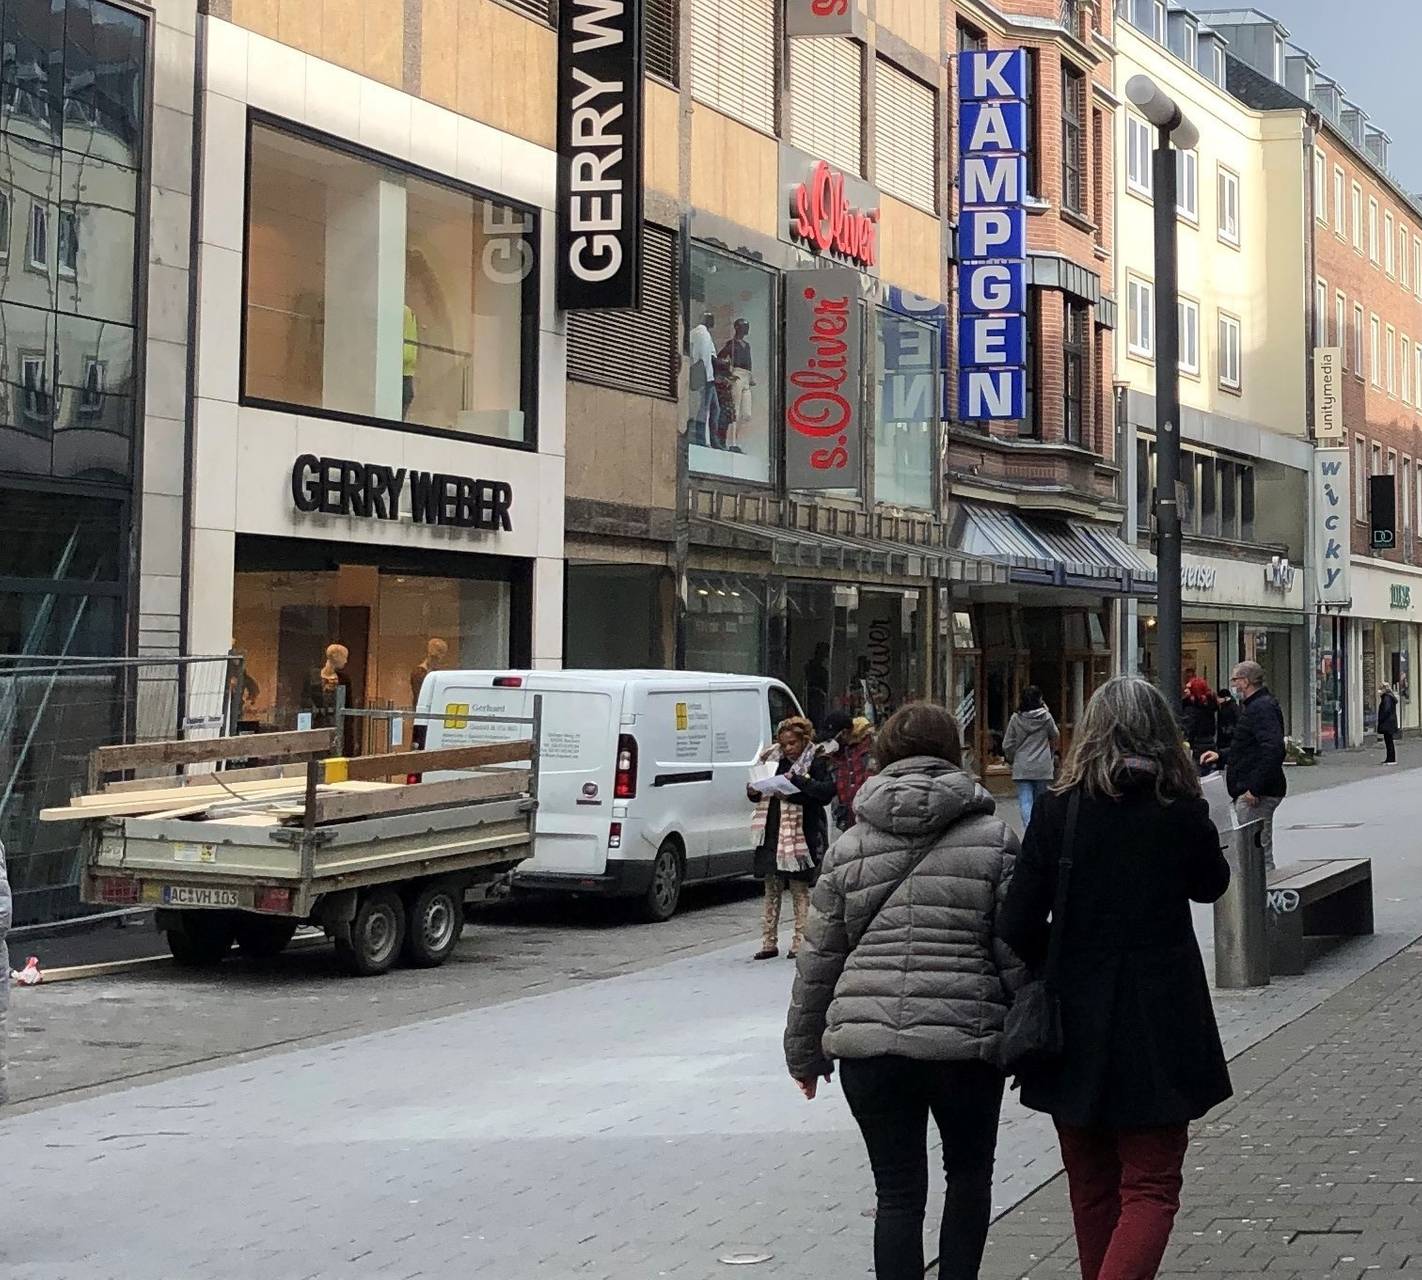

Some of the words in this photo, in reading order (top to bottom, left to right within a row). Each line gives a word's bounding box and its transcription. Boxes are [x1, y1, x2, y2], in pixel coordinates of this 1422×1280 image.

[569, 67, 623, 282] GERRY
[796, 158, 880, 268] s.Oliver
[963, 53, 1016, 417] KÄMPGEN
[787, 287, 852, 470] s.Oliver
[1322, 353, 1334, 432] unitymedia
[292, 453, 406, 520] GERRY
[408, 470, 513, 531] WEBER
[1321, 459, 1343, 589] wicky
[213, 891, 238, 905] 103
